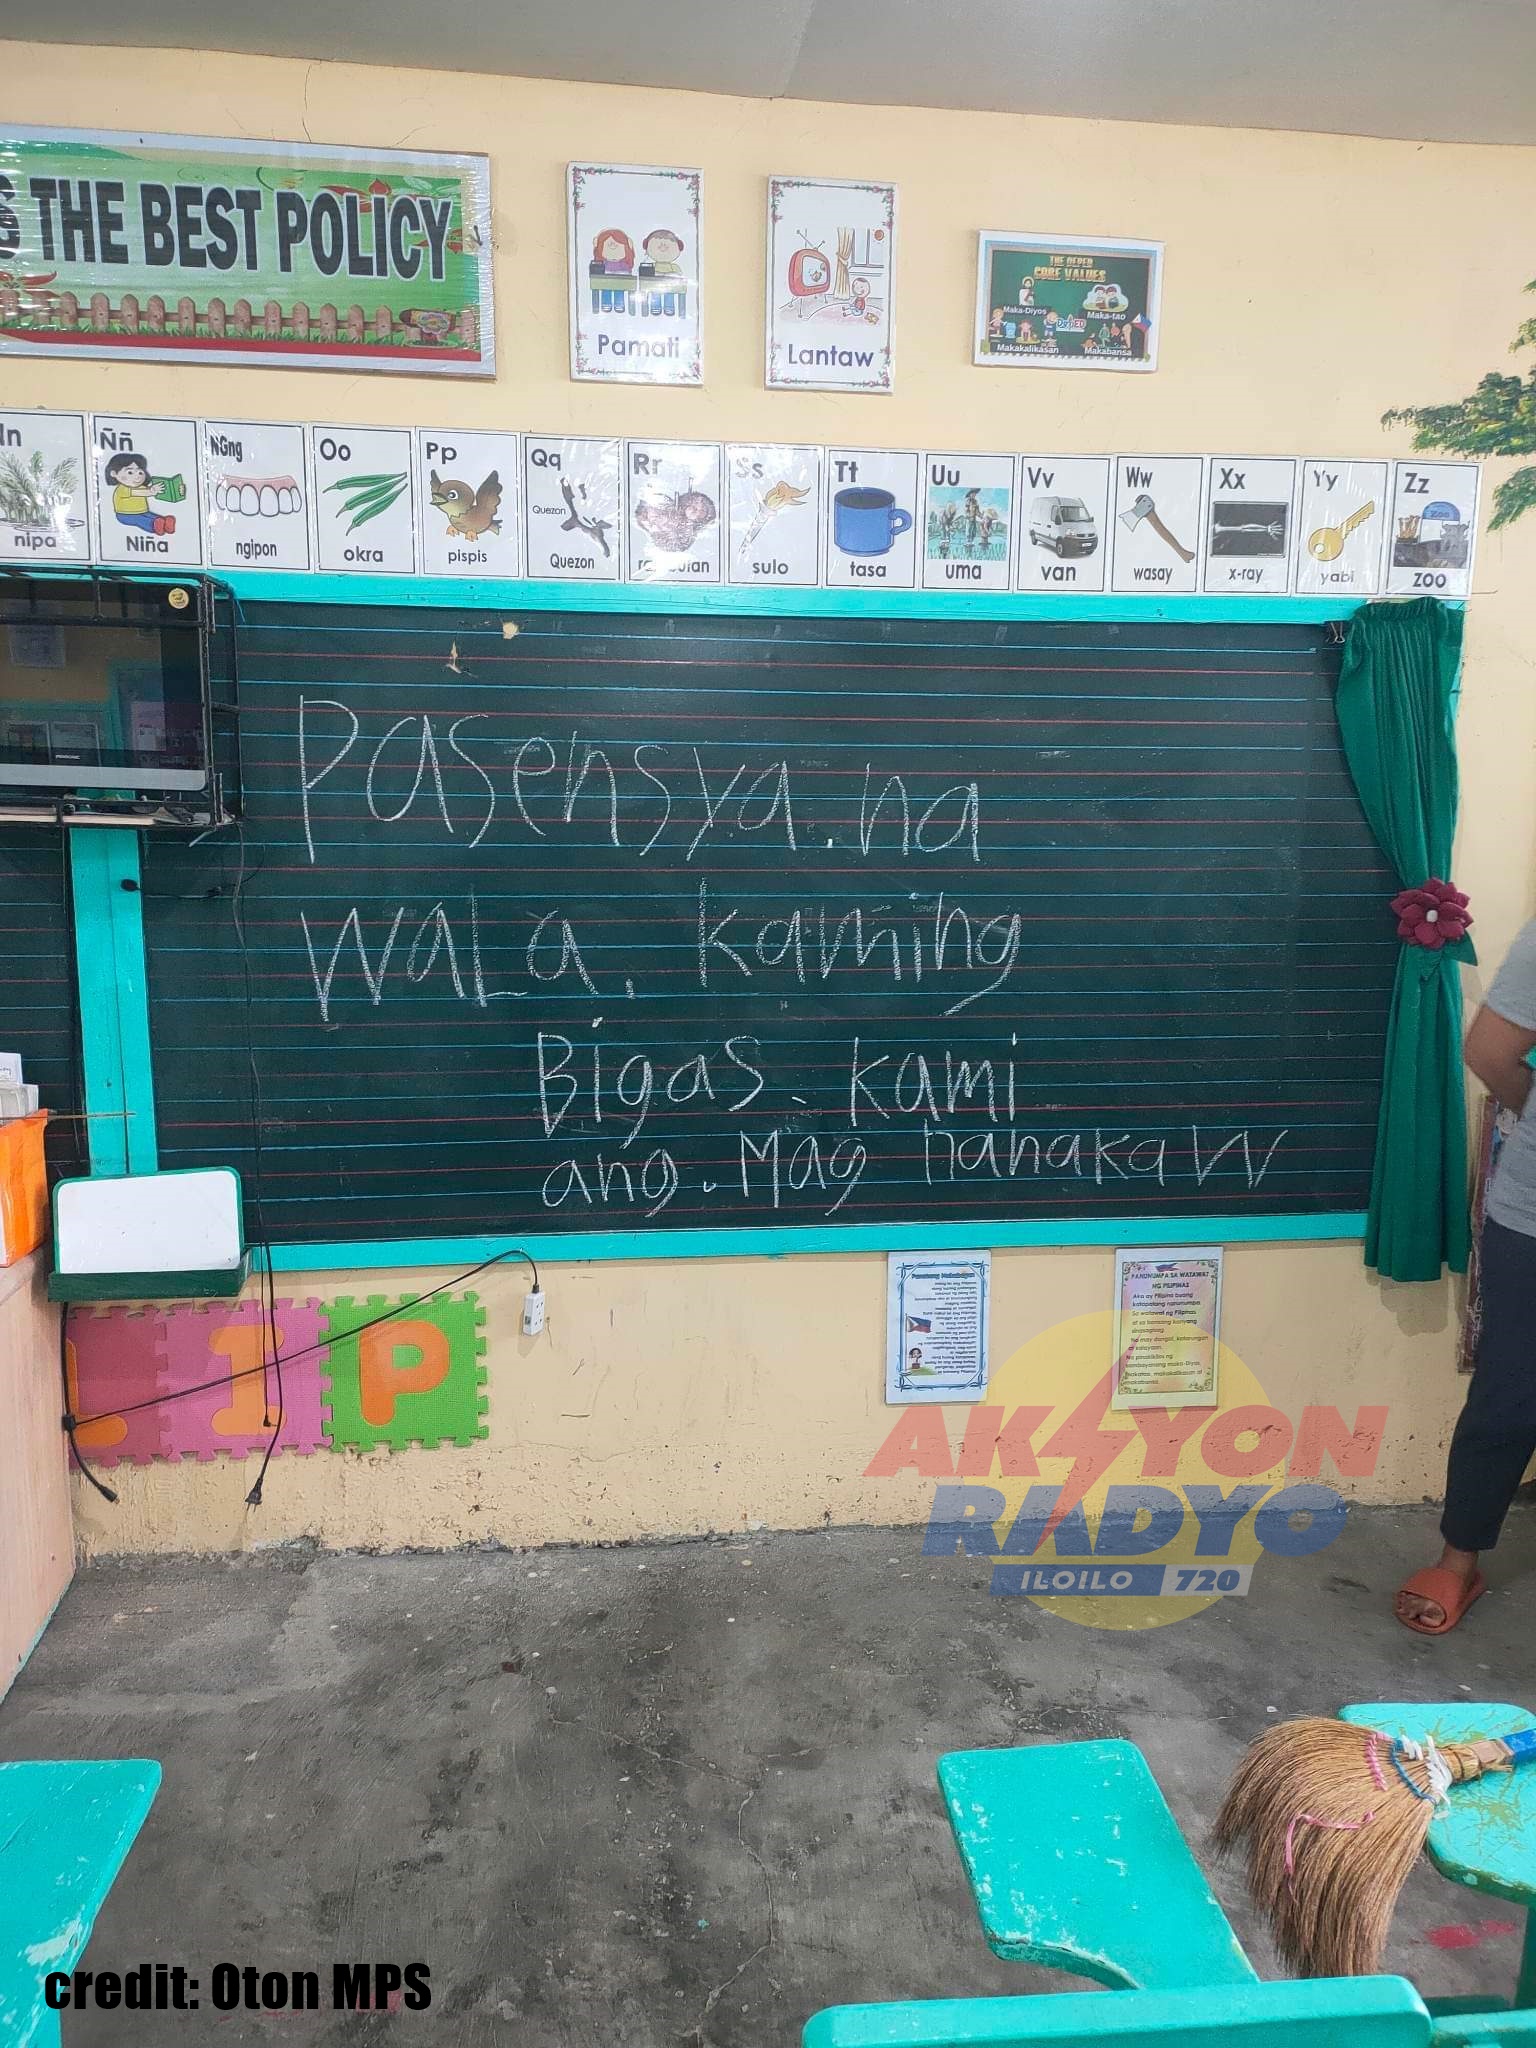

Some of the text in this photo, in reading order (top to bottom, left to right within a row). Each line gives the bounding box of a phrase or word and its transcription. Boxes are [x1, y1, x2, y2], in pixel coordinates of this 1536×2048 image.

[29, 176, 130, 265] THE
[139, 182, 262, 271] BEST
[276, 190, 452, 280] POLICY
[1050, 255, 1065, 267] THE
[1034, 266, 1107, 283] CORE VALUES
[1003, 305, 1047, 316] Maka-Diyos
[597, 333, 680, 359] Pamati
[788, 343, 874, 367] Lantaw
[997, 343, 1060, 354] Makakalikasan
[1085, 346, 1133, 356] Makabansa
[100, 427, 134, 452] Ññ
[319, 438, 352, 462] Oo
[425, 441, 457, 464] Pp
[531, 448, 562, 472] Qq
[633, 452, 662, 476] Rr
[834, 460, 859, 483] Tt
[931, 464, 961, 486] Uu
[1027, 467, 1055, 489] Vv
[1126, 466, 1153, 489] Ww
[1219, 467, 1247, 490] Xx
[1313, 470, 1339, 491] Yy
[1404, 472, 1430, 494] Zz
[532, 504, 567, 517] Quezon
[14, 532, 57, 552] nipa
[126, 534, 169, 554] Niña
[236, 538, 278, 561] ngipon
[343, 544, 384, 563] okra
[447, 548, 488, 565] pispis
[549, 552, 595, 570] Quezon
[752, 558, 789, 575] sulo
[850, 560, 887, 578] tasa
[945, 563, 982, 580] uma
[1041, 565, 1077, 582] van
[1133, 567, 1173, 585] wasay
[1229, 567, 1264, 584] x-ray
[1320, 570, 1354, 586] yabi
[860, 761, 981, 862] na
[739, 1128, 867, 1217] Mag
[359, 1319, 451, 1427] P
